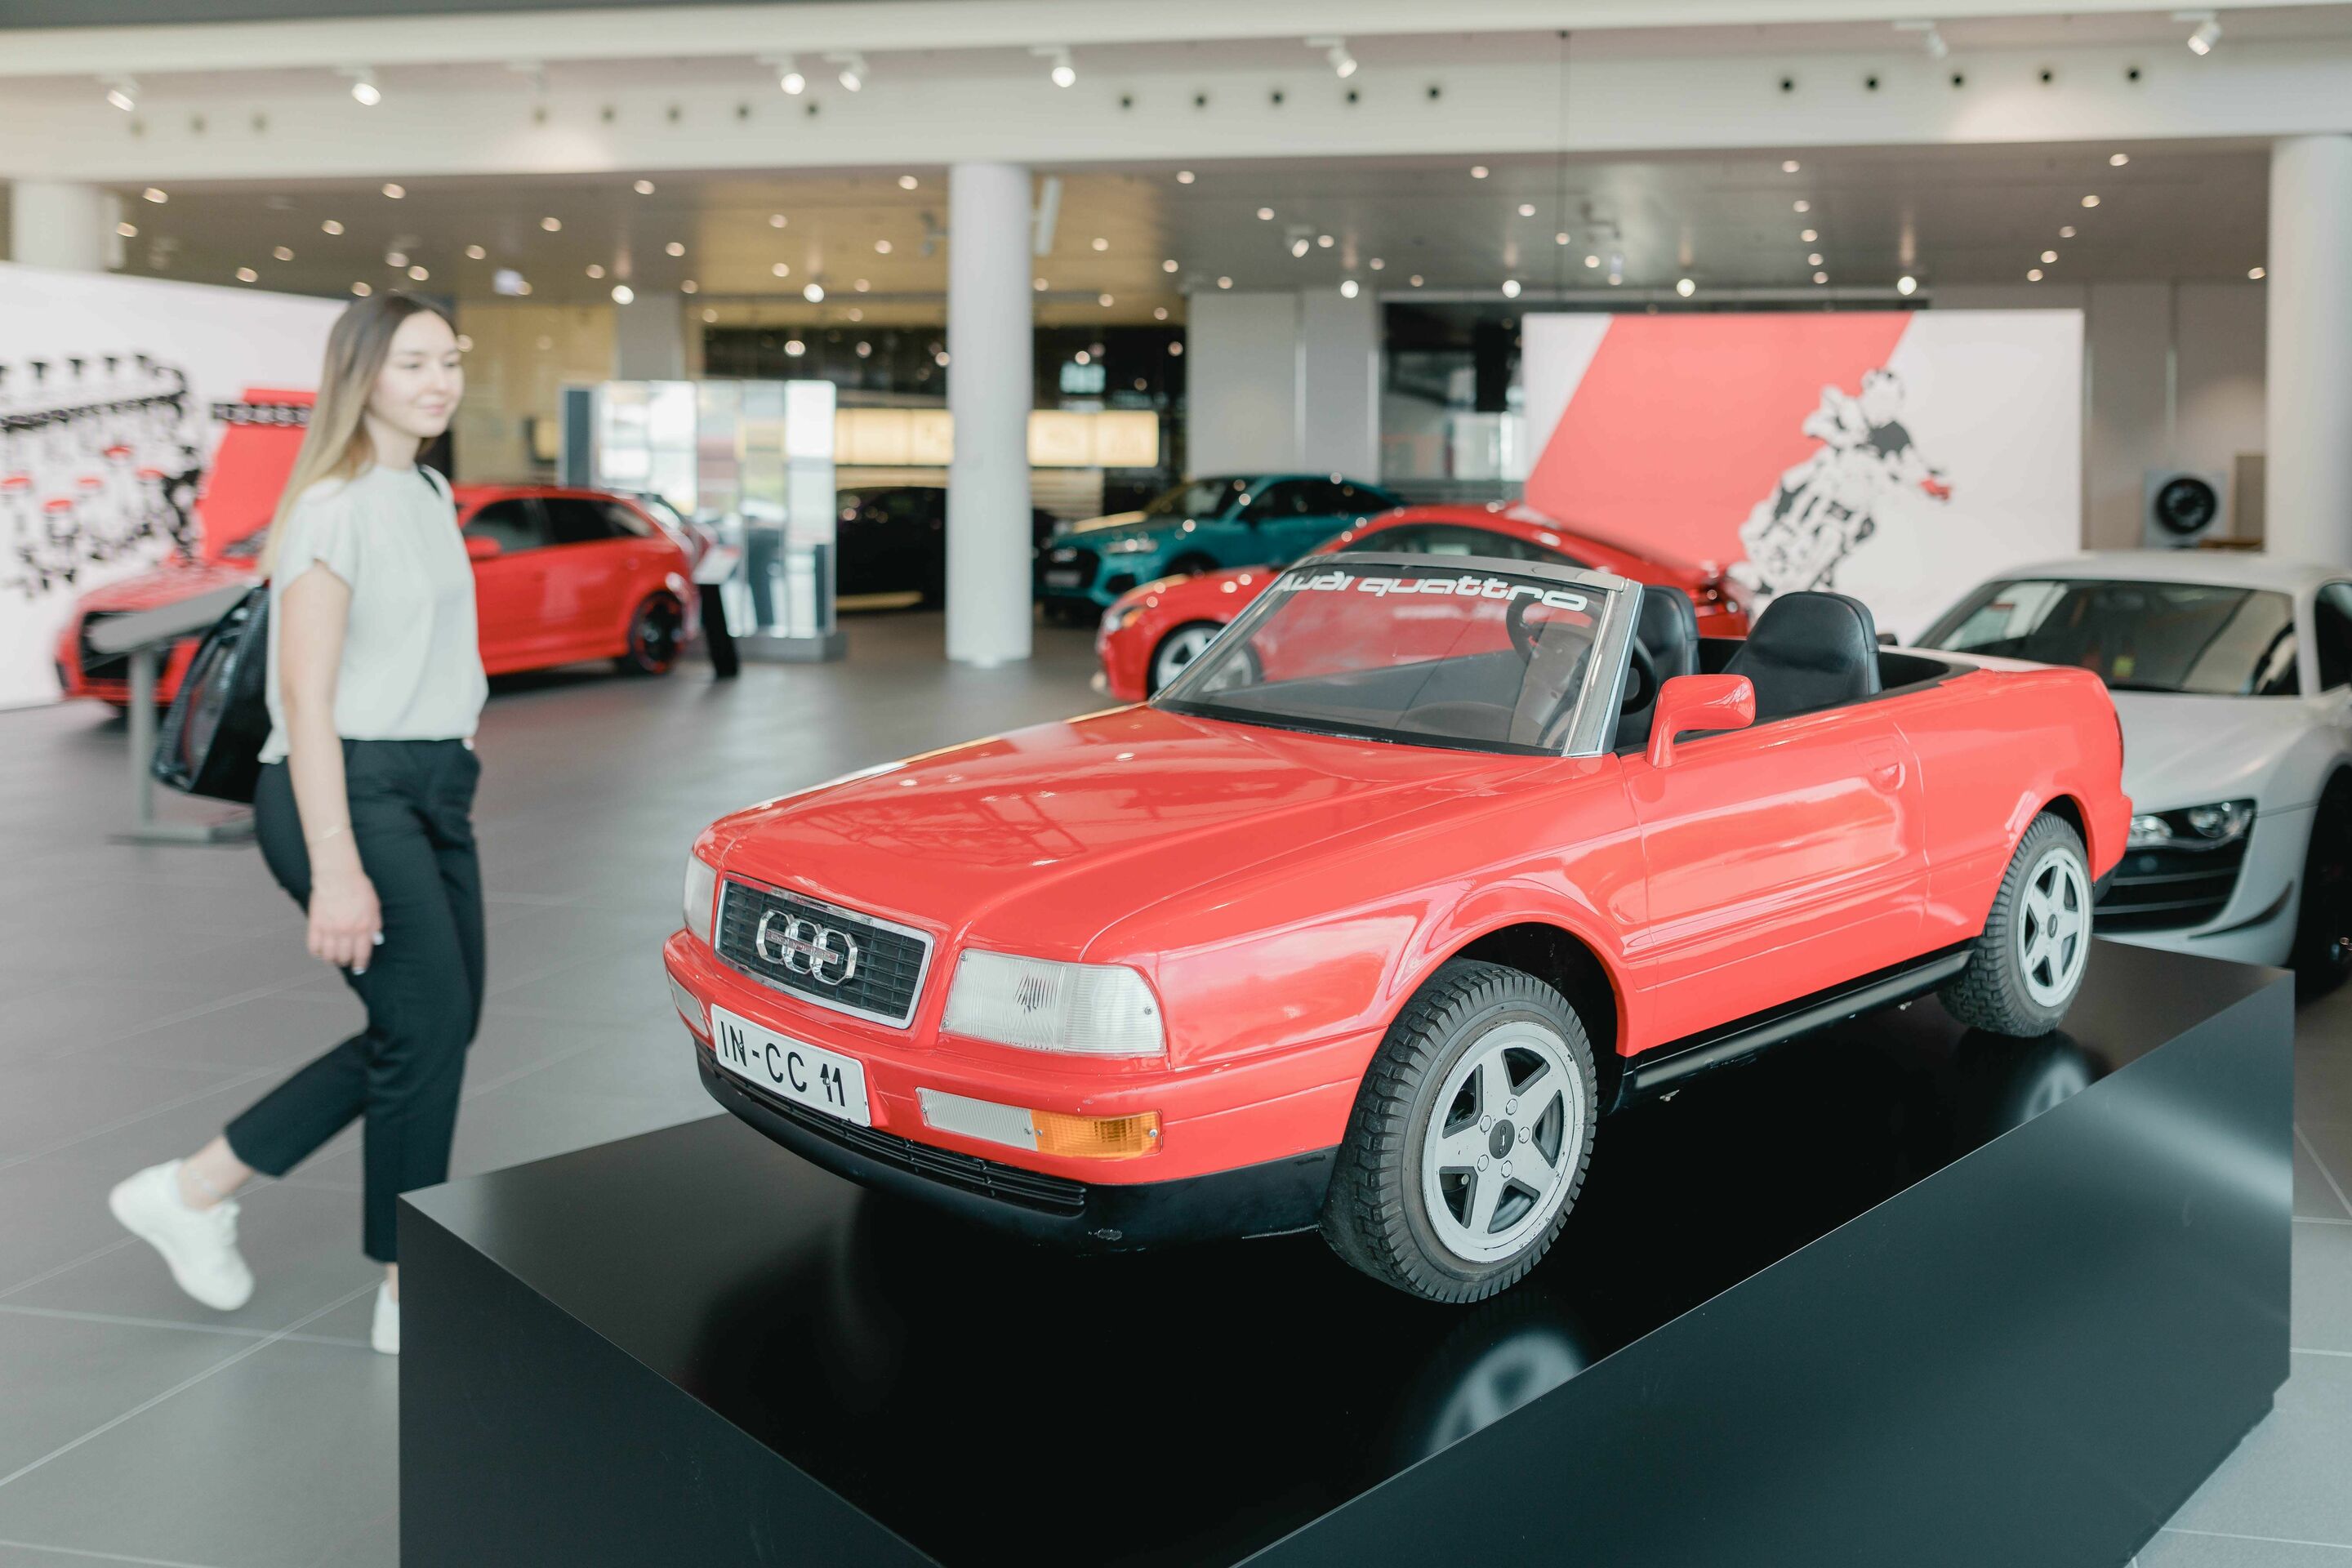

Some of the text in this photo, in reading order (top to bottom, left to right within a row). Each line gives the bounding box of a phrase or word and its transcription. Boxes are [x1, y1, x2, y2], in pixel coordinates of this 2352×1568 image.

[1356, 575, 1588, 612] quattro
[720, 1021, 845, 1107] IN-CC 11
